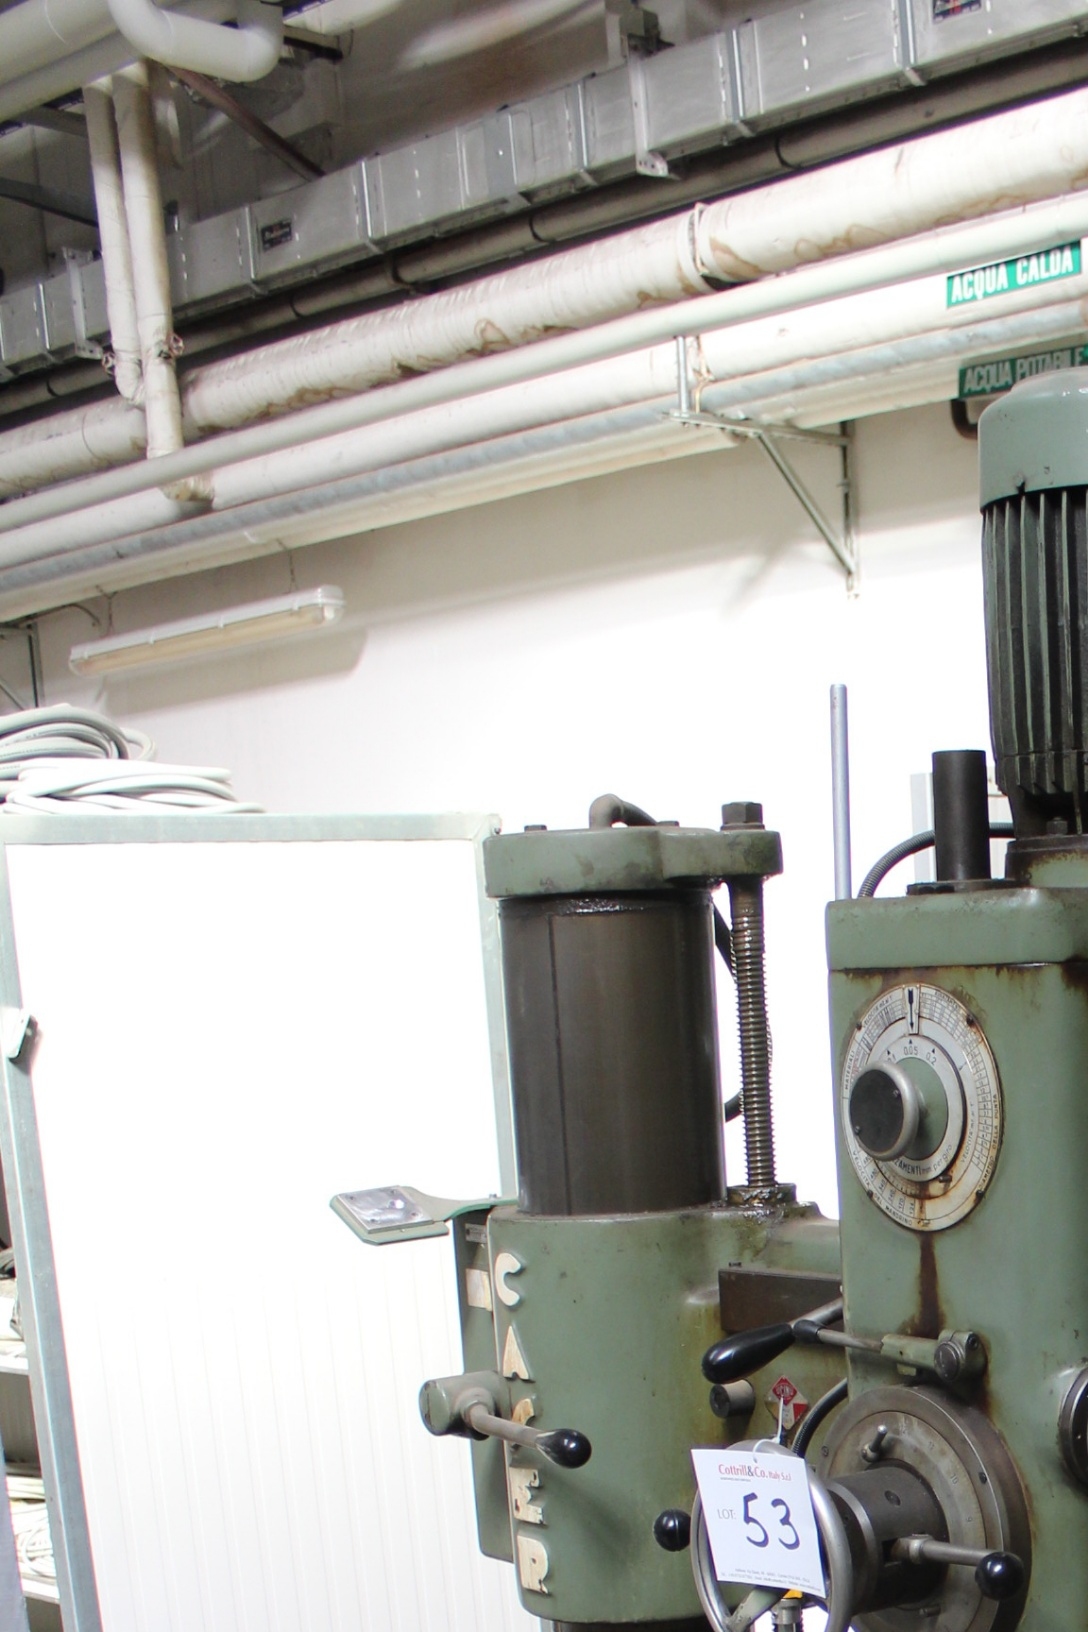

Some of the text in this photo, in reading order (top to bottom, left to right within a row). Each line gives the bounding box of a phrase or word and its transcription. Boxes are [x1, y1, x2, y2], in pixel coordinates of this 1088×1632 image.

[951, 246, 1074, 300] ACQUA CALDA
[963, 360, 1013, 393] ACQUA
[717, 1492, 800, 1550] LOT: 53
